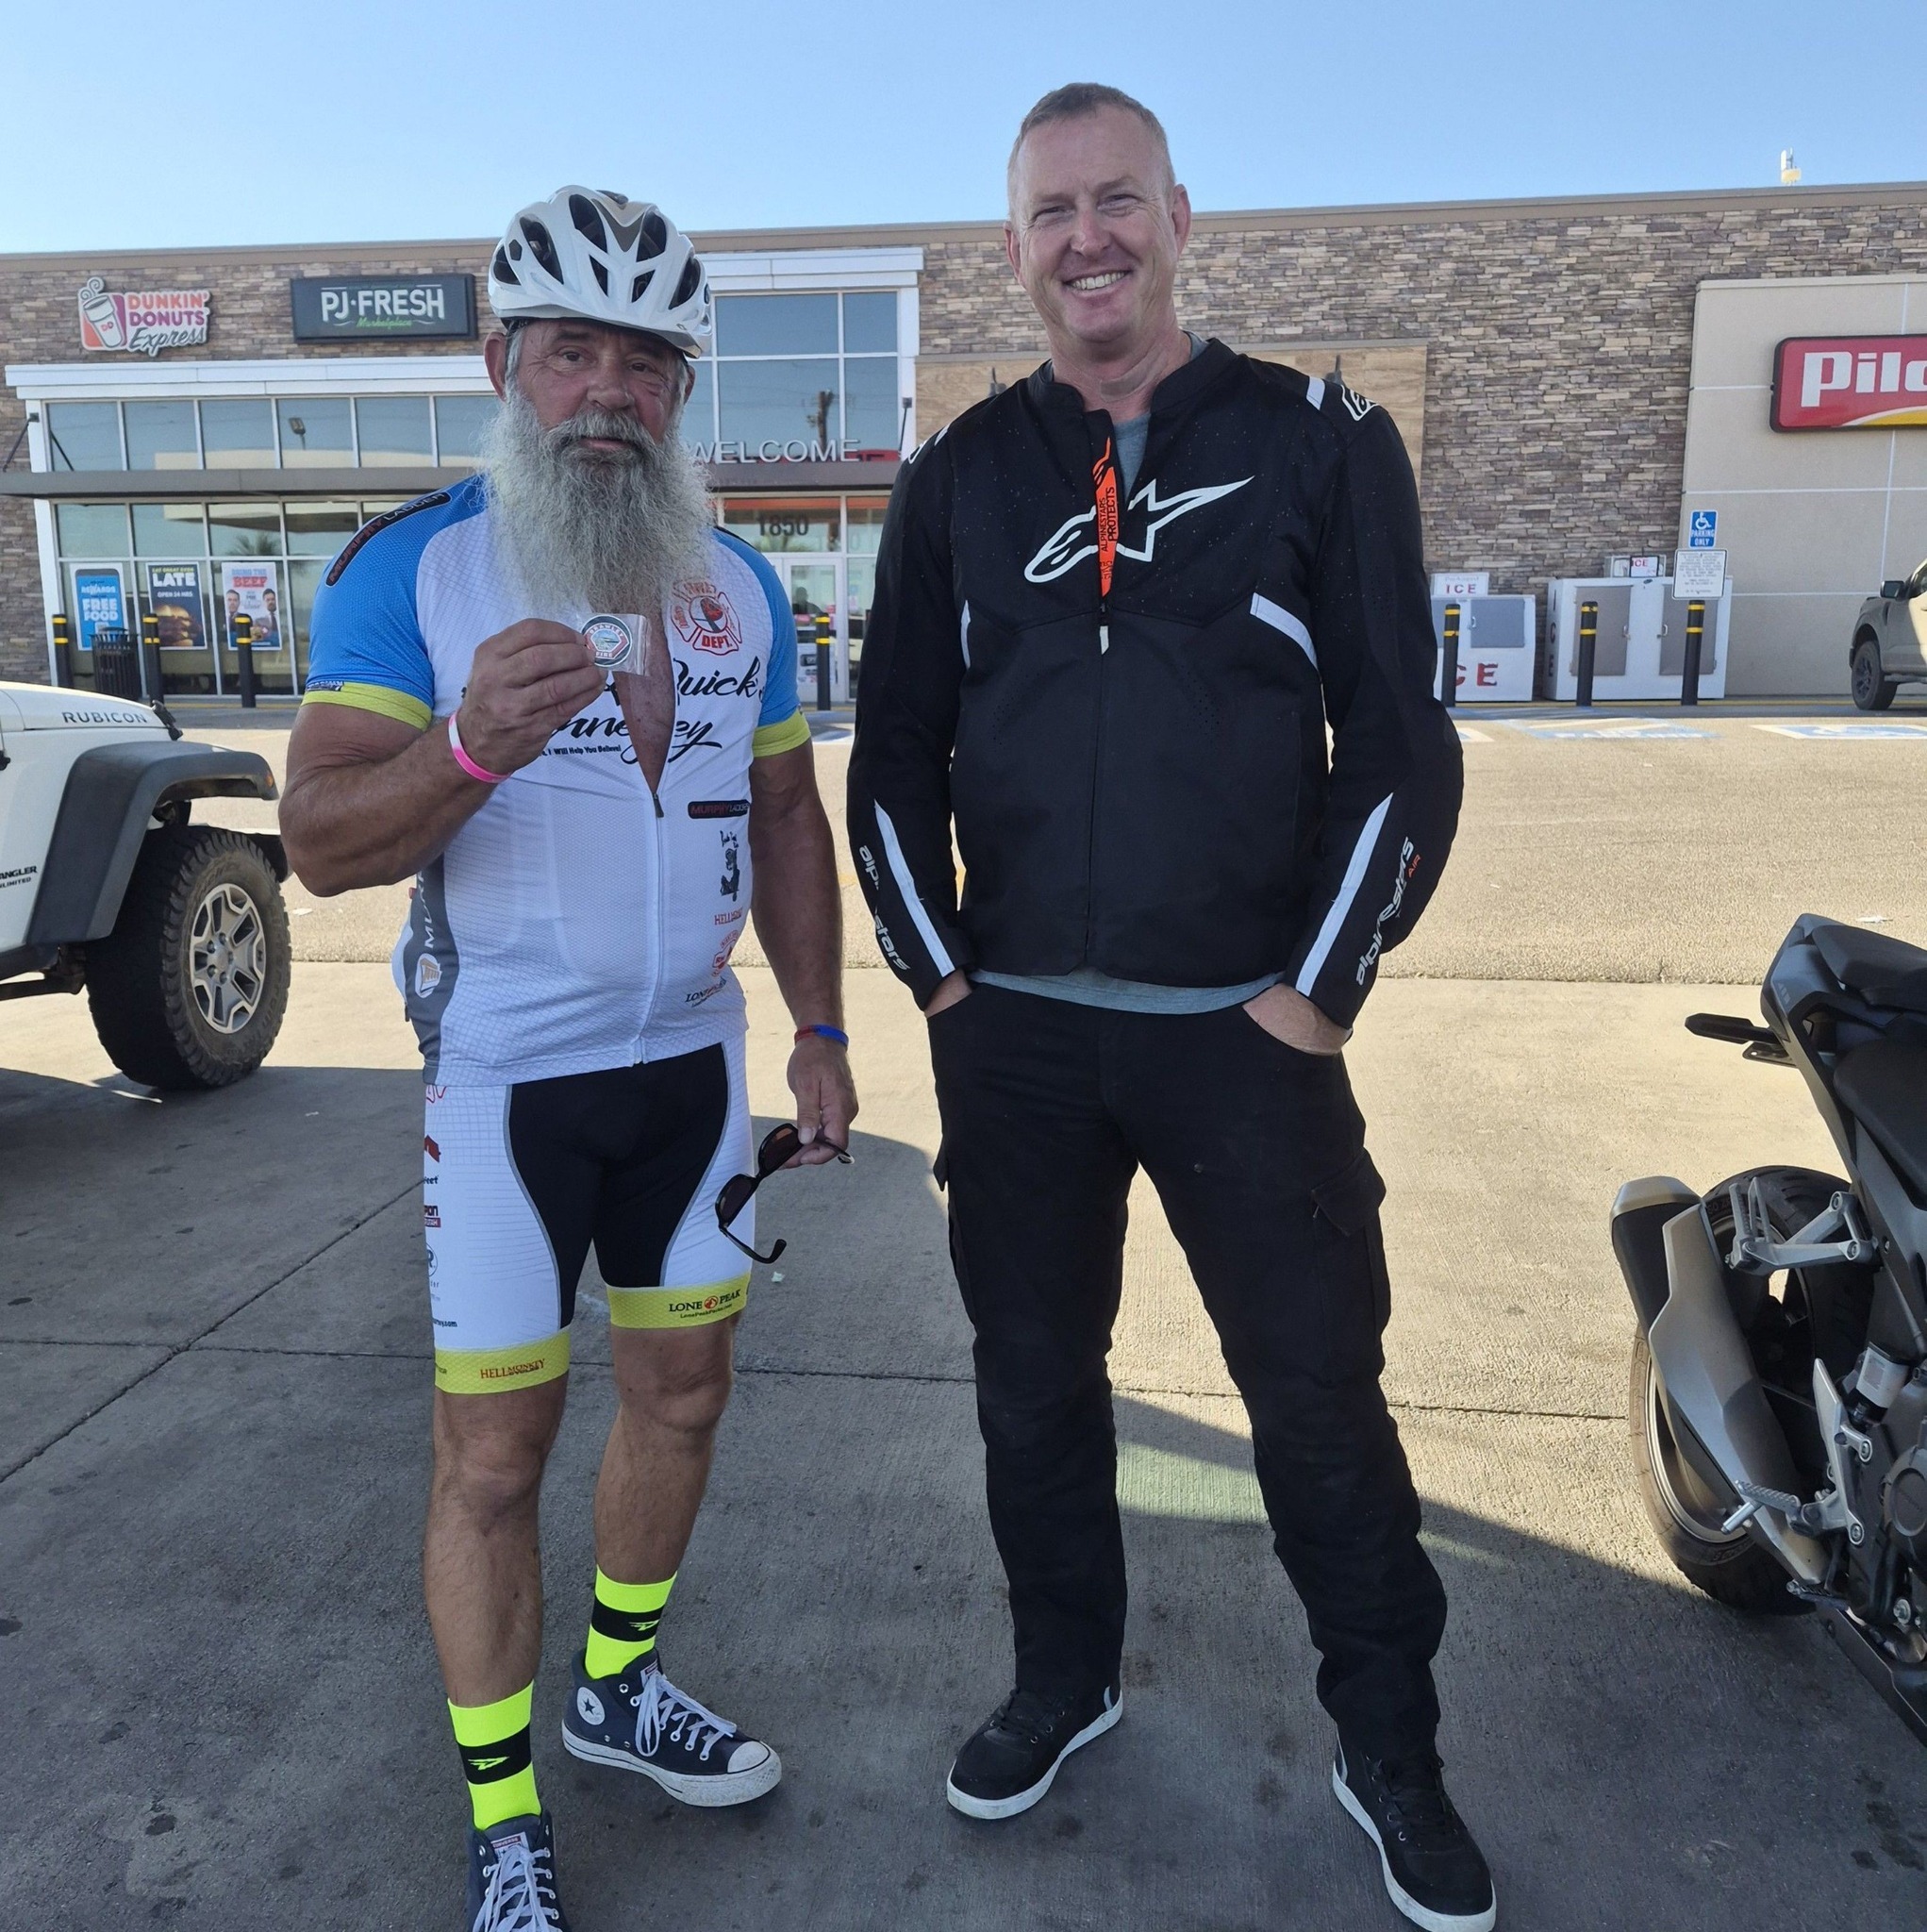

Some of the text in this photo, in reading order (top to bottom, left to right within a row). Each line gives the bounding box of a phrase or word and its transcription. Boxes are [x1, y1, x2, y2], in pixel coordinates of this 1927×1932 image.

[127, 293, 208, 309] DUNKIN'
[129, 310, 205, 326] DONUTS
[128, 326, 205, 352] Express
[691, 439, 860, 464] WELCOME
[1105, 486, 1118, 542] PROTECTS
[758, 514, 809, 537] 1850
[1694, 538, 1710, 546] ONLY
[152, 573, 196, 588] LATE
[1446, 584, 1477, 594] ICE
[82, 598, 117, 610] FREE
[84, 610, 118, 622] FOOD
[62, 712, 148, 724] RUBICON
[569, 747, 584, 756] Help
[1409, 854, 1421, 878] AIR
[669, 1289, 741, 1312] LONE PEAK
